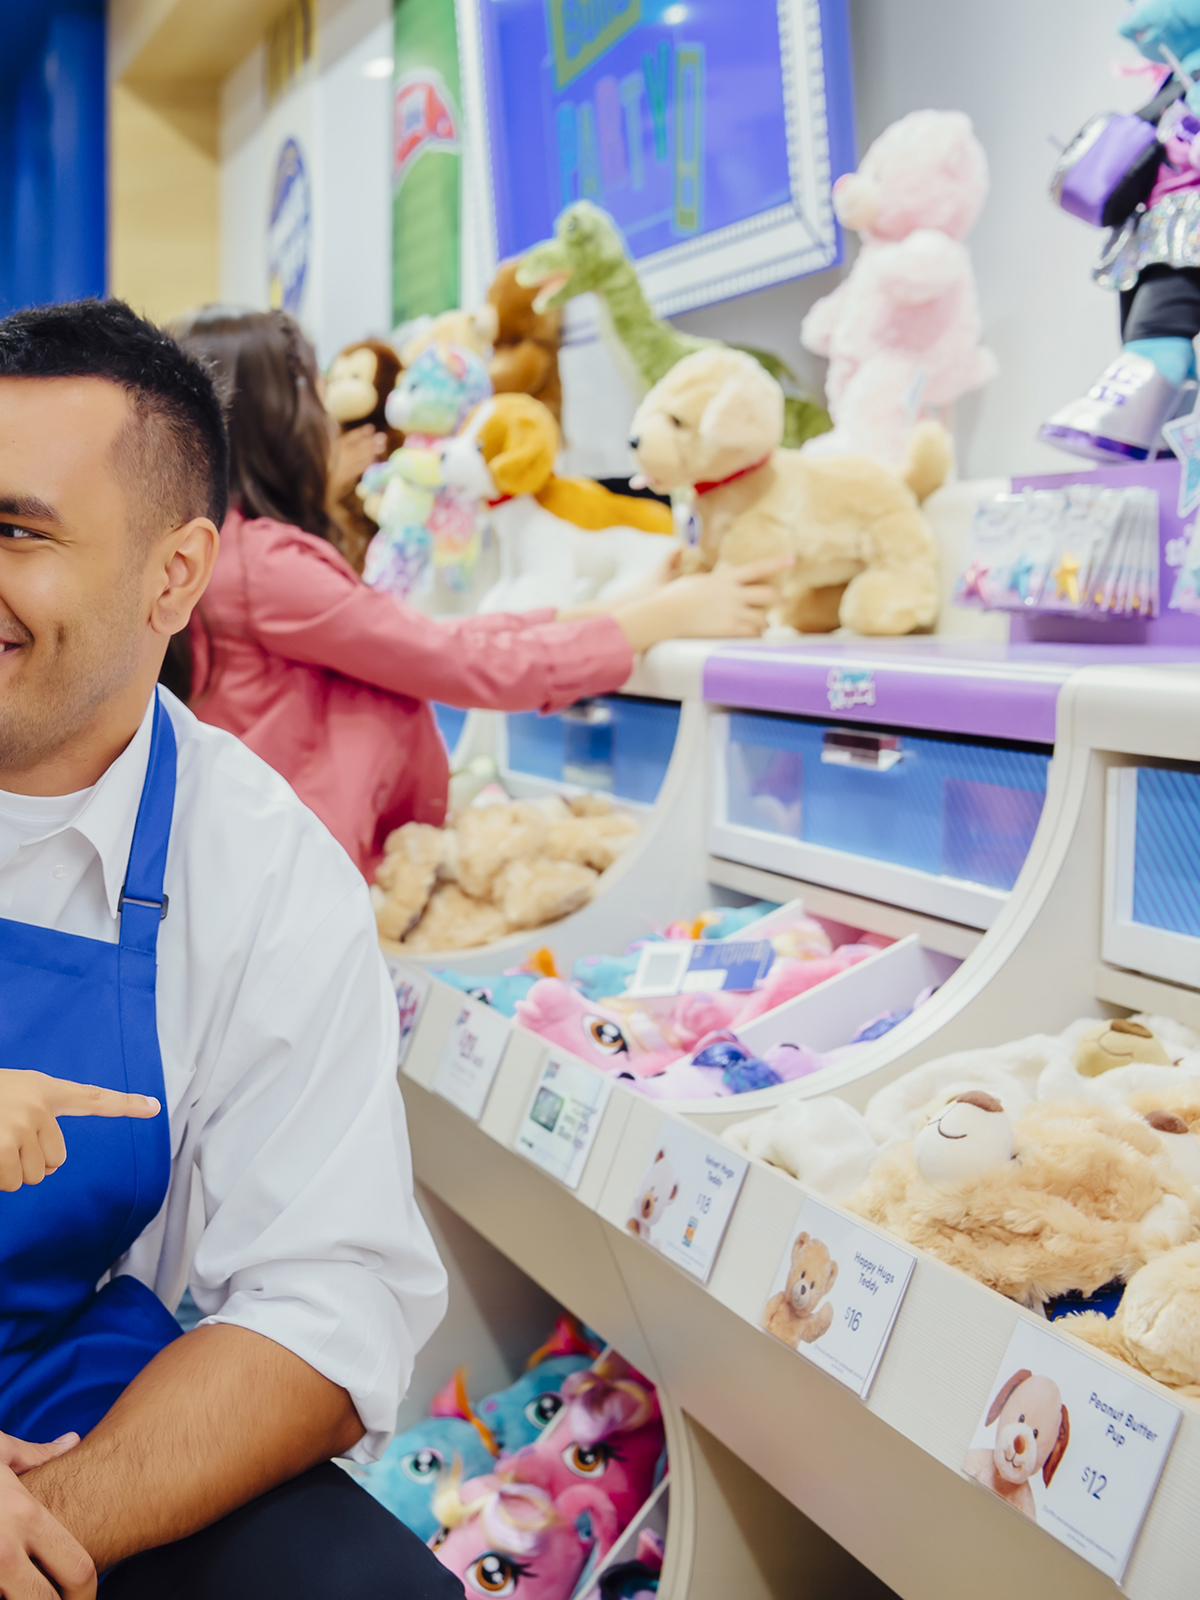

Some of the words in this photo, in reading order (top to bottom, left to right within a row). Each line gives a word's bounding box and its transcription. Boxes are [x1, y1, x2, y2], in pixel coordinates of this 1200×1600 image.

[853, 1250, 877, 1275] Happy
[876, 1264, 895, 1285] Hugs
[858, 1272, 880, 1296] Teddy
[844, 1306, 863, 1332] $16
[1088, 1390, 1125, 1422] Peanut
[1124, 1412, 1158, 1443] Butter
[1104, 1422, 1126, 1448] Pup
[1081, 1465, 1108, 1501] $12
